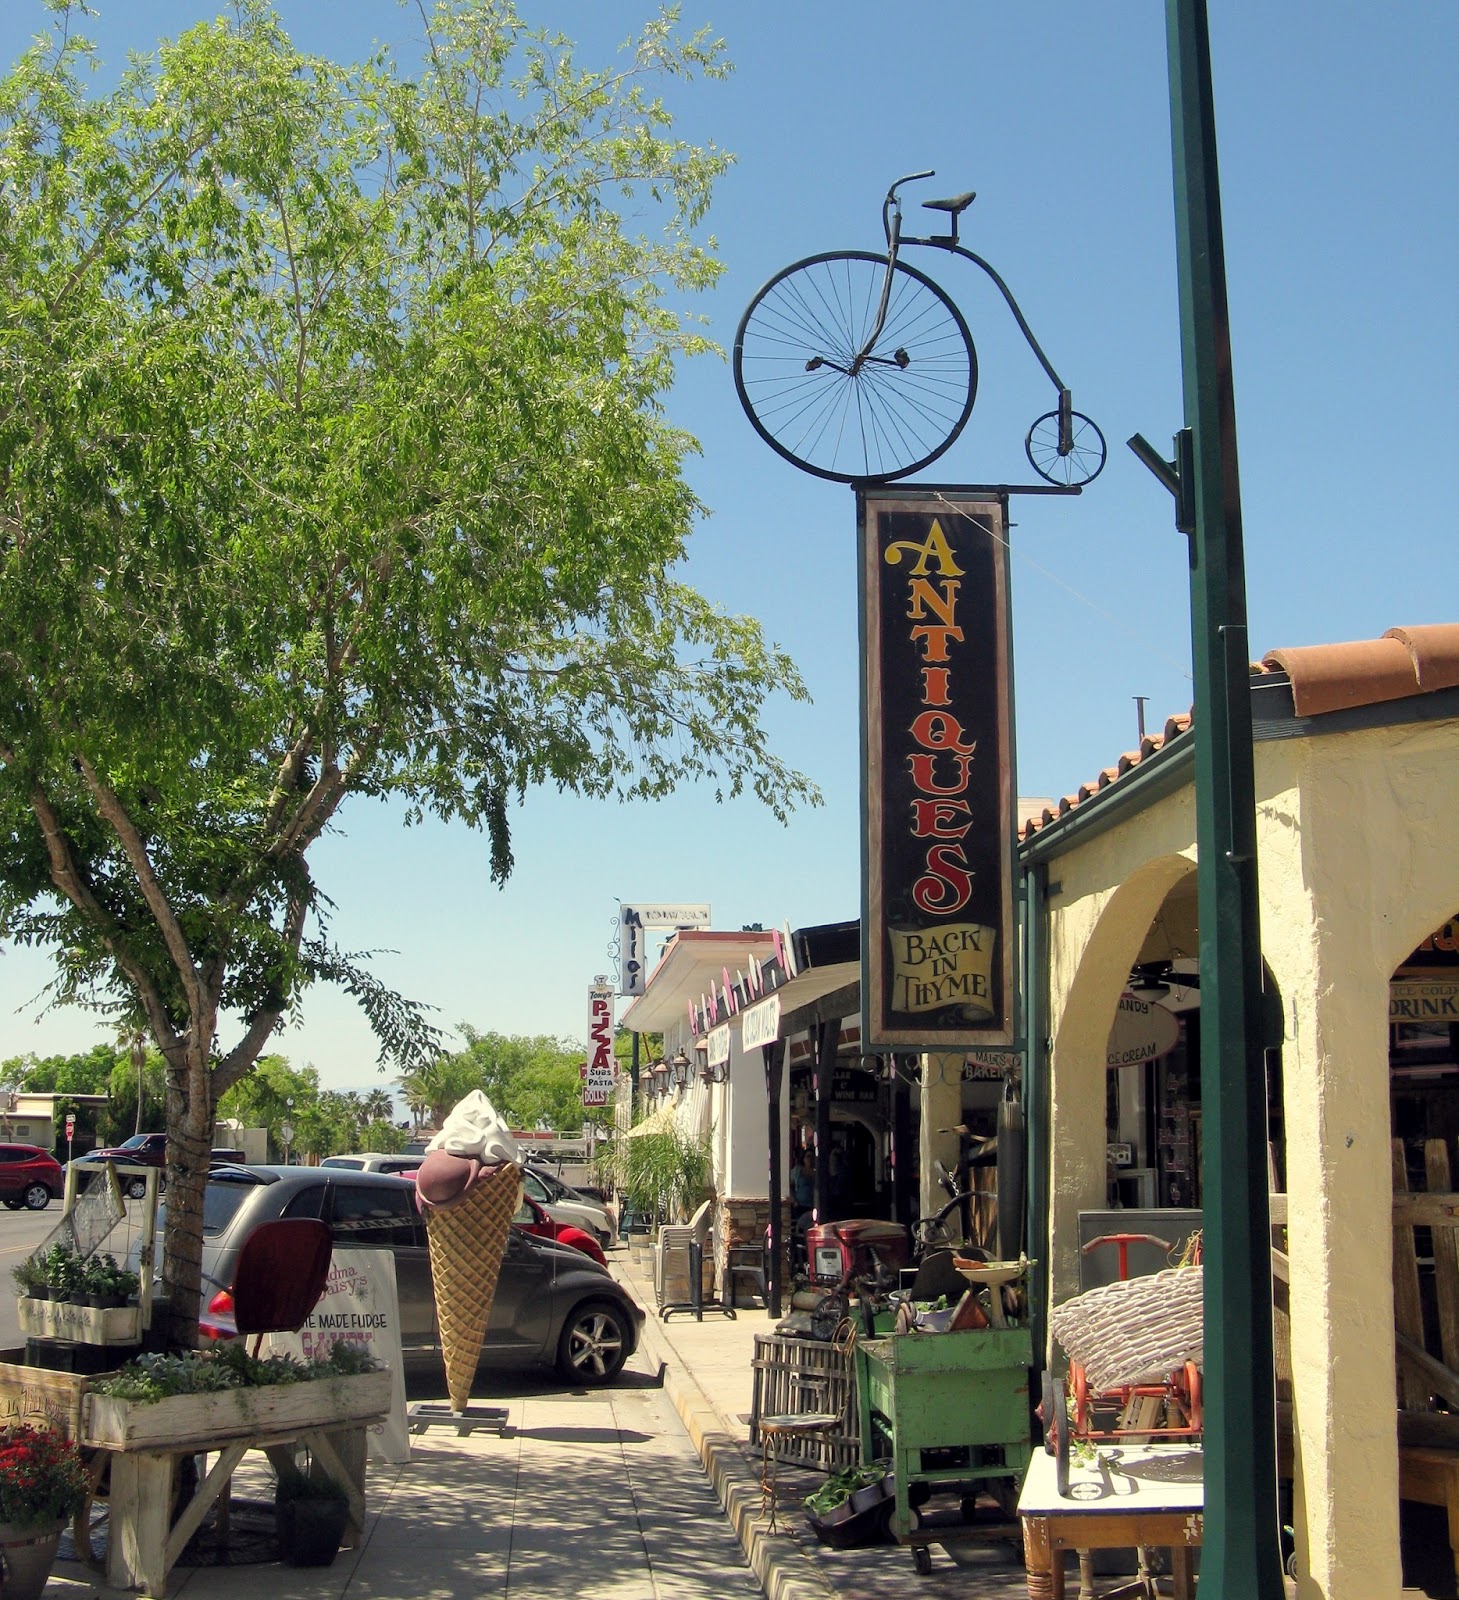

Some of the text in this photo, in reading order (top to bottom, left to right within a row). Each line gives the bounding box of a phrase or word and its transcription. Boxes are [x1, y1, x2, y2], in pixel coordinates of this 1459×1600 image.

[884, 517, 978, 915] ANTIQUES
[903, 930, 983, 965] BACK
[931, 953, 958, 977] IN
[897, 973, 988, 1011] THYME
[1421, 986, 1458, 996] COLD
[1118, 999, 1149, 1014] ANDY
[1107, 1042, 1156, 1065] CE CREAM
[588, 1079, 613, 1087] PASTA
[319, 1313, 348, 1329] MADE
[351, 1313, 387, 1329] FUDGE
